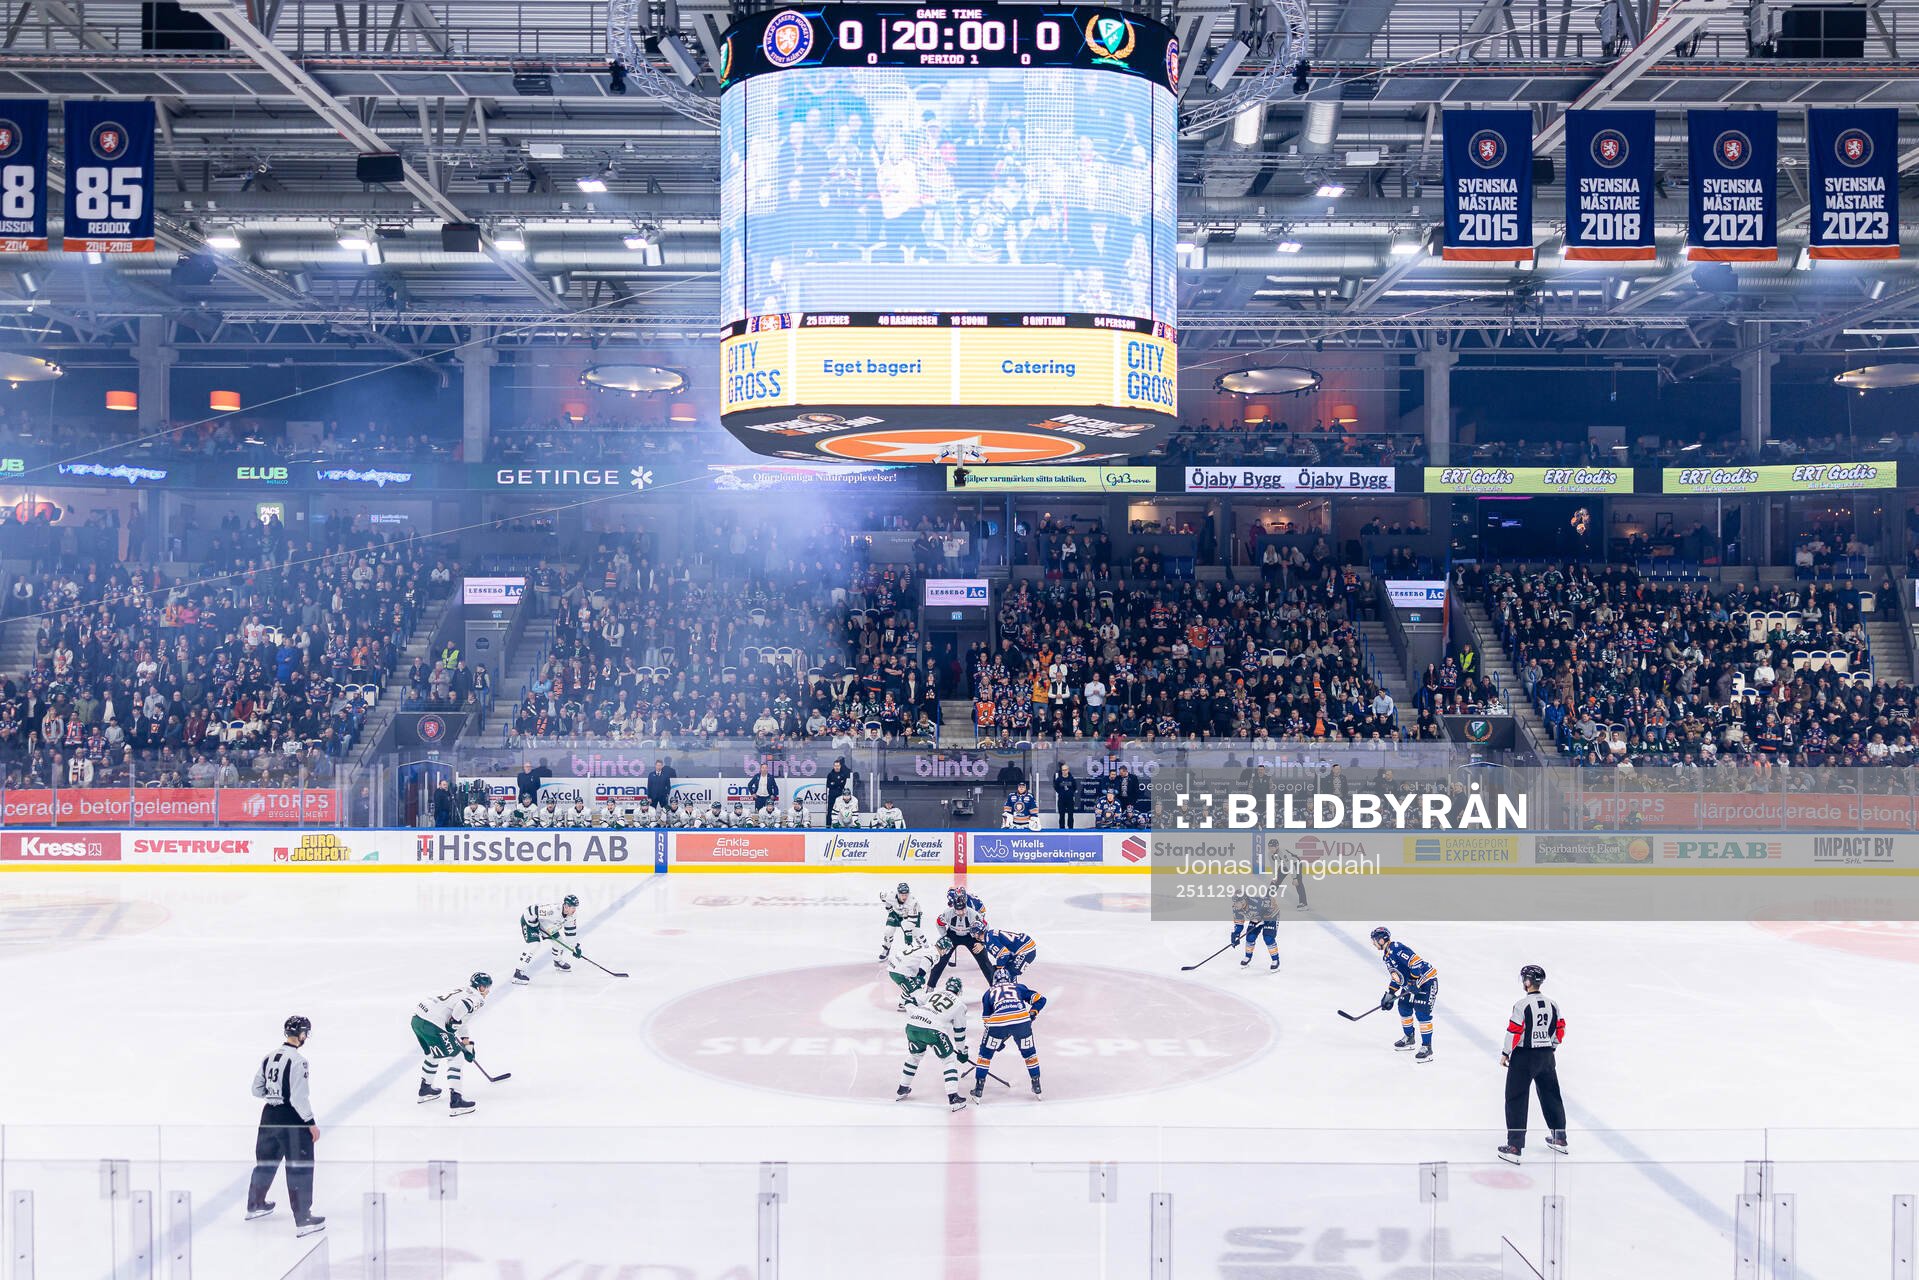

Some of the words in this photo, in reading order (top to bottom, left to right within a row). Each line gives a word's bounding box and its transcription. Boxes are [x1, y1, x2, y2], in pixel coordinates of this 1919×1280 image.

[916, 9, 947, 19] GAME
[952, 9, 982, 19] TIME
[839, 20, 863, 50] 0
[892, 20, 1006, 51] 20:00
[1036, 21, 1060, 51] 0
[867, 53, 878, 64] 0
[920, 54, 965, 64] PERIOD
[970, 54, 979, 64] 1
[1021, 54, 1031, 64] 0
[1458, 178, 1518, 193] SVENSKA
[1580, 178, 1640, 193] SVENSKA
[1703, 179, 1763, 194] SVENSKA
[1824, 177, 1886, 192] SVENSKA
[76, 167, 143, 219] 85
[1458, 193, 1518, 210] MÄSTARE
[1580, 193, 1640, 210] MÄSTARE
[1703, 194, 1763, 211] MÄSTARE
[1826, 192, 1885, 210] MÄSTARE
[88, 222, 130, 234] REDDOX
[1458, 213, 1518, 240] 2015
[1580, 213, 1640, 240] 2018
[1703, 214, 1763, 241] 2021
[1822, 211, 1889, 240] 2023
[890, 315, 938, 326] RASMUSSEN
[1105, 318, 1136, 330] PERSSON
[728, 341, 759, 374] CITY
[1127, 341, 1165, 373] CITY
[823, 359, 862, 376] Eget
[867, 359, 922, 377] bageri
[1002, 360, 1076, 377] Catering
[728, 369, 781, 404] GROSS
[1127, 371, 1174, 406] GROSS
[497, 469, 619, 485] GETINGE
[816, 473, 897, 483] Naturupplevelser!
[1036, 475, 1052, 483] sätta
[1054, 475, 1087, 483] taktiken.
[1192, 468, 1237, 490] Öjaby
[1243, 471, 1282, 489] Bygg
[1298, 468, 1343, 490] Öjaby
[1350, 471, 1387, 489] Bygg
[1440, 469, 1470, 484] ERT
[1471, 469, 1514, 484] Godis
[1544, 469, 1573, 484] ERT
[1574, 469, 1617, 484] Godis
[1679, 469, 1707, 484] ERT
[1711, 469, 1758, 484] Godis
[1792, 466, 1825, 481] ERT
[1828, 464, 1878, 480] Godis
[571, 754, 645, 777] blinto
[743, 754, 817, 777] blinto
[915, 754, 989, 777] blinto
[1087, 755, 1160, 777] blinto
[541, 789, 580, 801] Axcell
[595, 783, 647, 796] öman
[674, 789, 712, 801] Axcell
[268, 794, 329, 809] TORPS
[21, 837, 86, 857] Kress
[134, 839, 250, 854] SVETRUCK
[302, 834, 335, 848] EURO
[439, 834, 571, 861] Hisstech
[583, 835, 629, 861] AB
[656, 833, 665, 864] CCM
[717, 837, 750, 847] Enkla
[837, 839, 870, 848] Svensk
[910, 839, 943, 848] Svensk
[1011, 840, 1045, 848] Wikells
[1321, 840, 1367, 857] VIDA
[1445, 838, 1509, 849] GARAGEPORT
[1814, 837, 1871, 857] IMPACT
[1874, 837, 1894, 857] BY
[290, 846, 347, 862] JACKPOT
[712, 847, 769, 858] Elbolaget
[841, 849, 867, 858] Cater
[914, 849, 941, 858] Cater
[1013, 850, 1097, 861] byggberäkningar
[1154, 842, 1235, 857] Standout
[1445, 849, 1509, 862] EXPERTEN
[1538, 843, 1595, 855] Sparbanken
[1676, 842, 1768, 859] PEAB
[1537, 1013, 1548, 1026] 29
[1054, 1036, 1233, 1057] SPEL
[268, 1068, 279, 1083] 43
